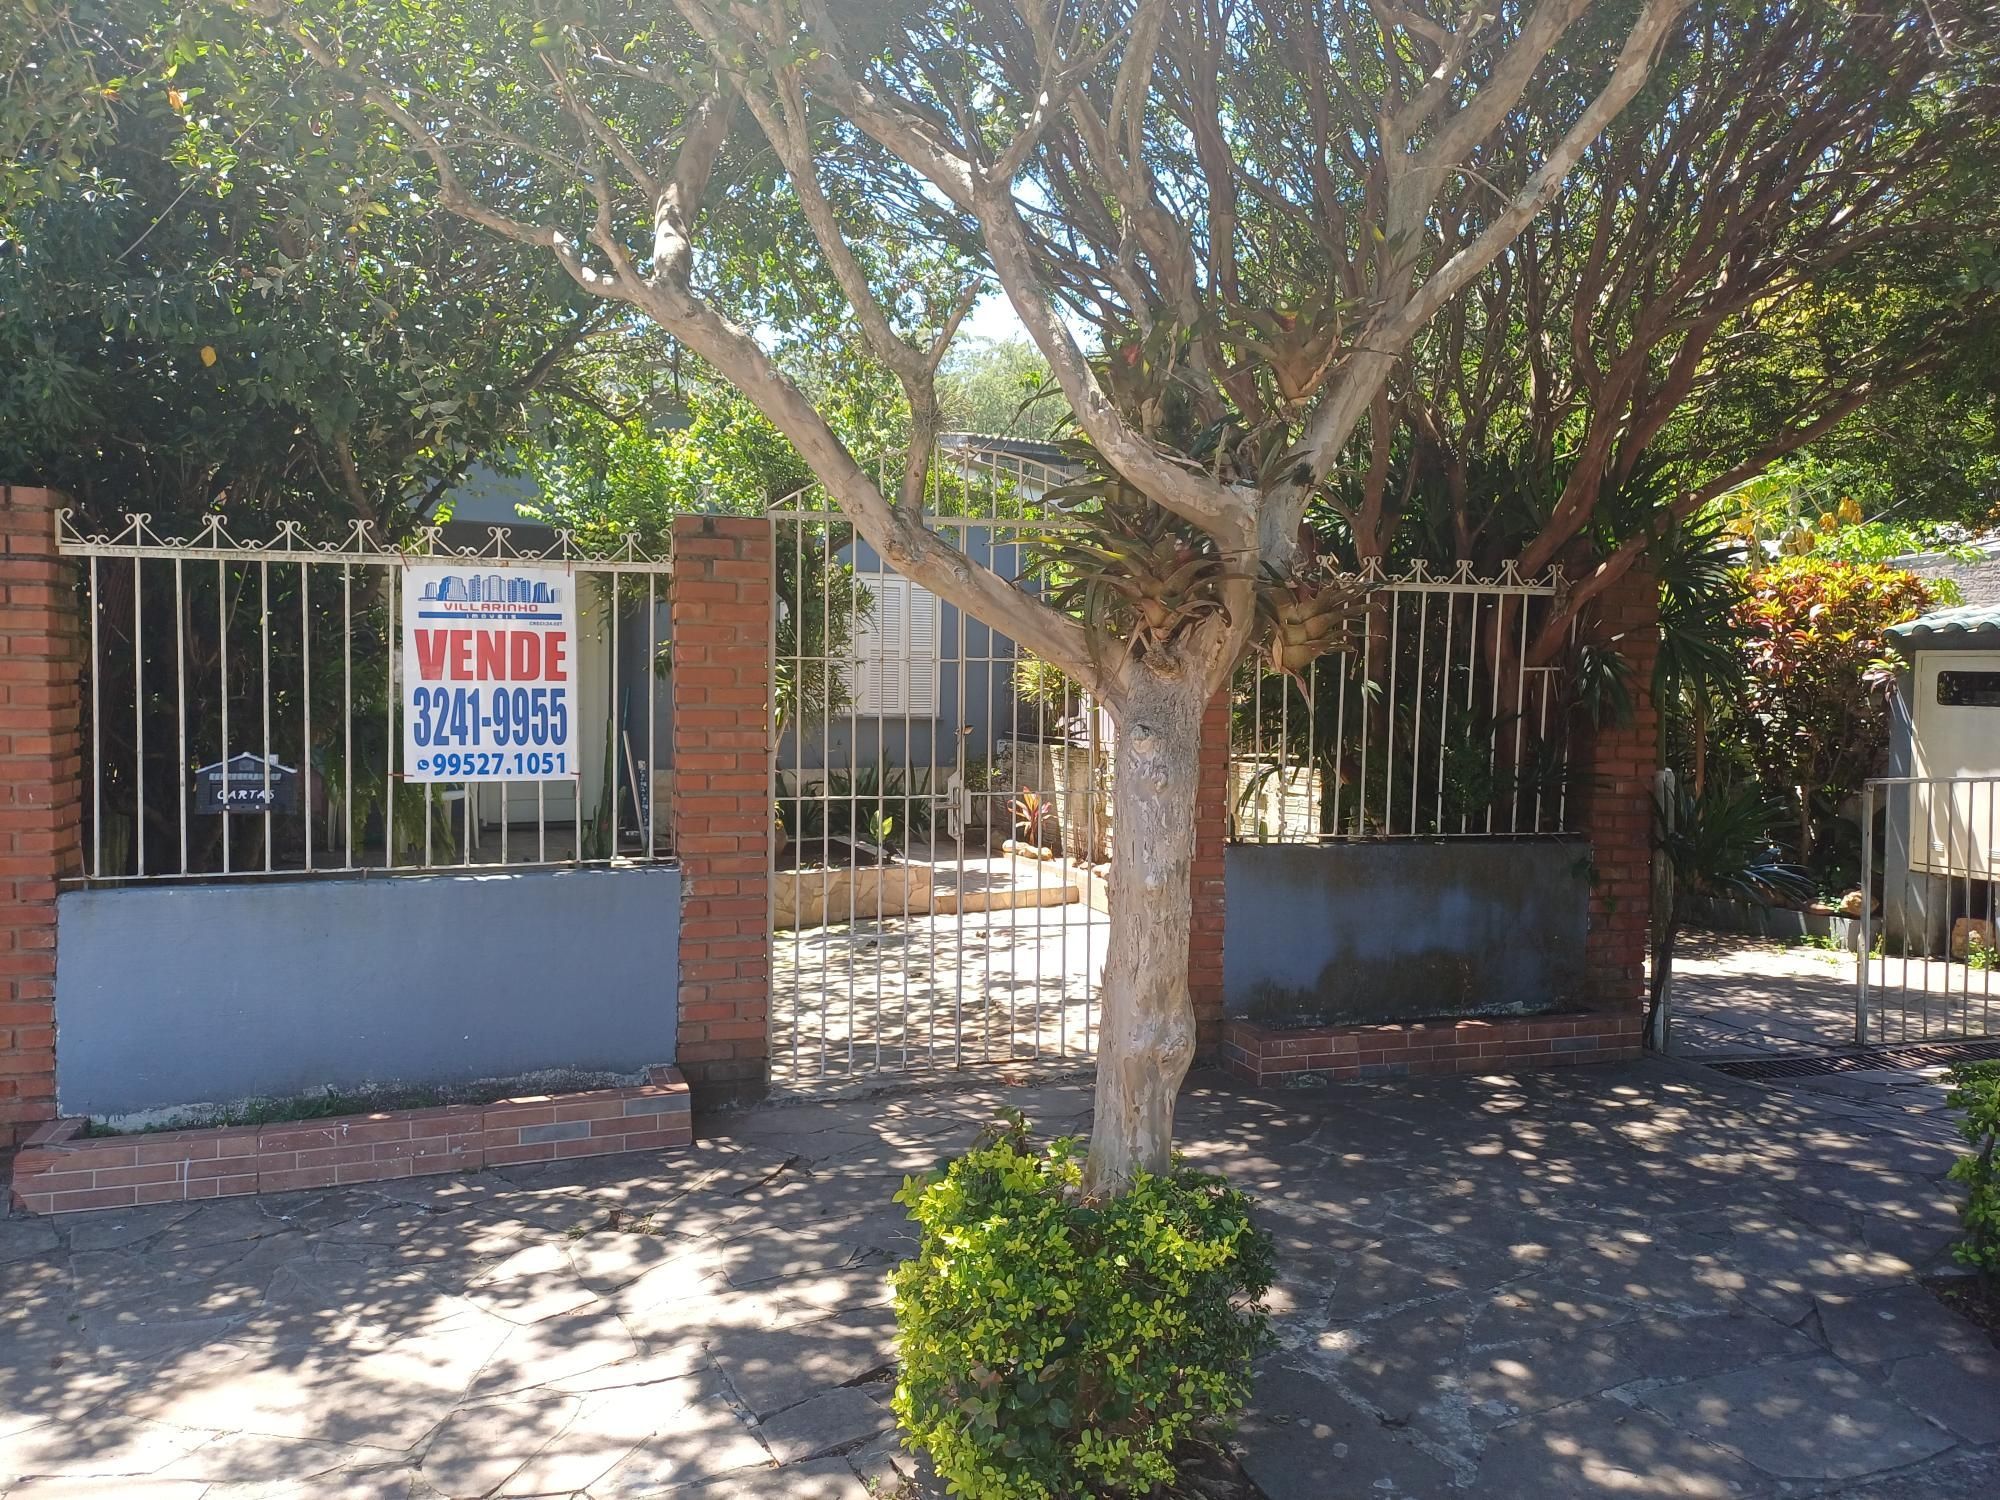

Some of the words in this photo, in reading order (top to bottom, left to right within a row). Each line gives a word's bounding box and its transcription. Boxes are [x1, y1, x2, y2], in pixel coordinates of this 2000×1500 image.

[414, 629, 567, 681] VENDE
[413, 686, 567, 747] 3241-9955
[433, 752, 566, 776] 99527.1051
[217, 789, 275, 800] CARTAS
